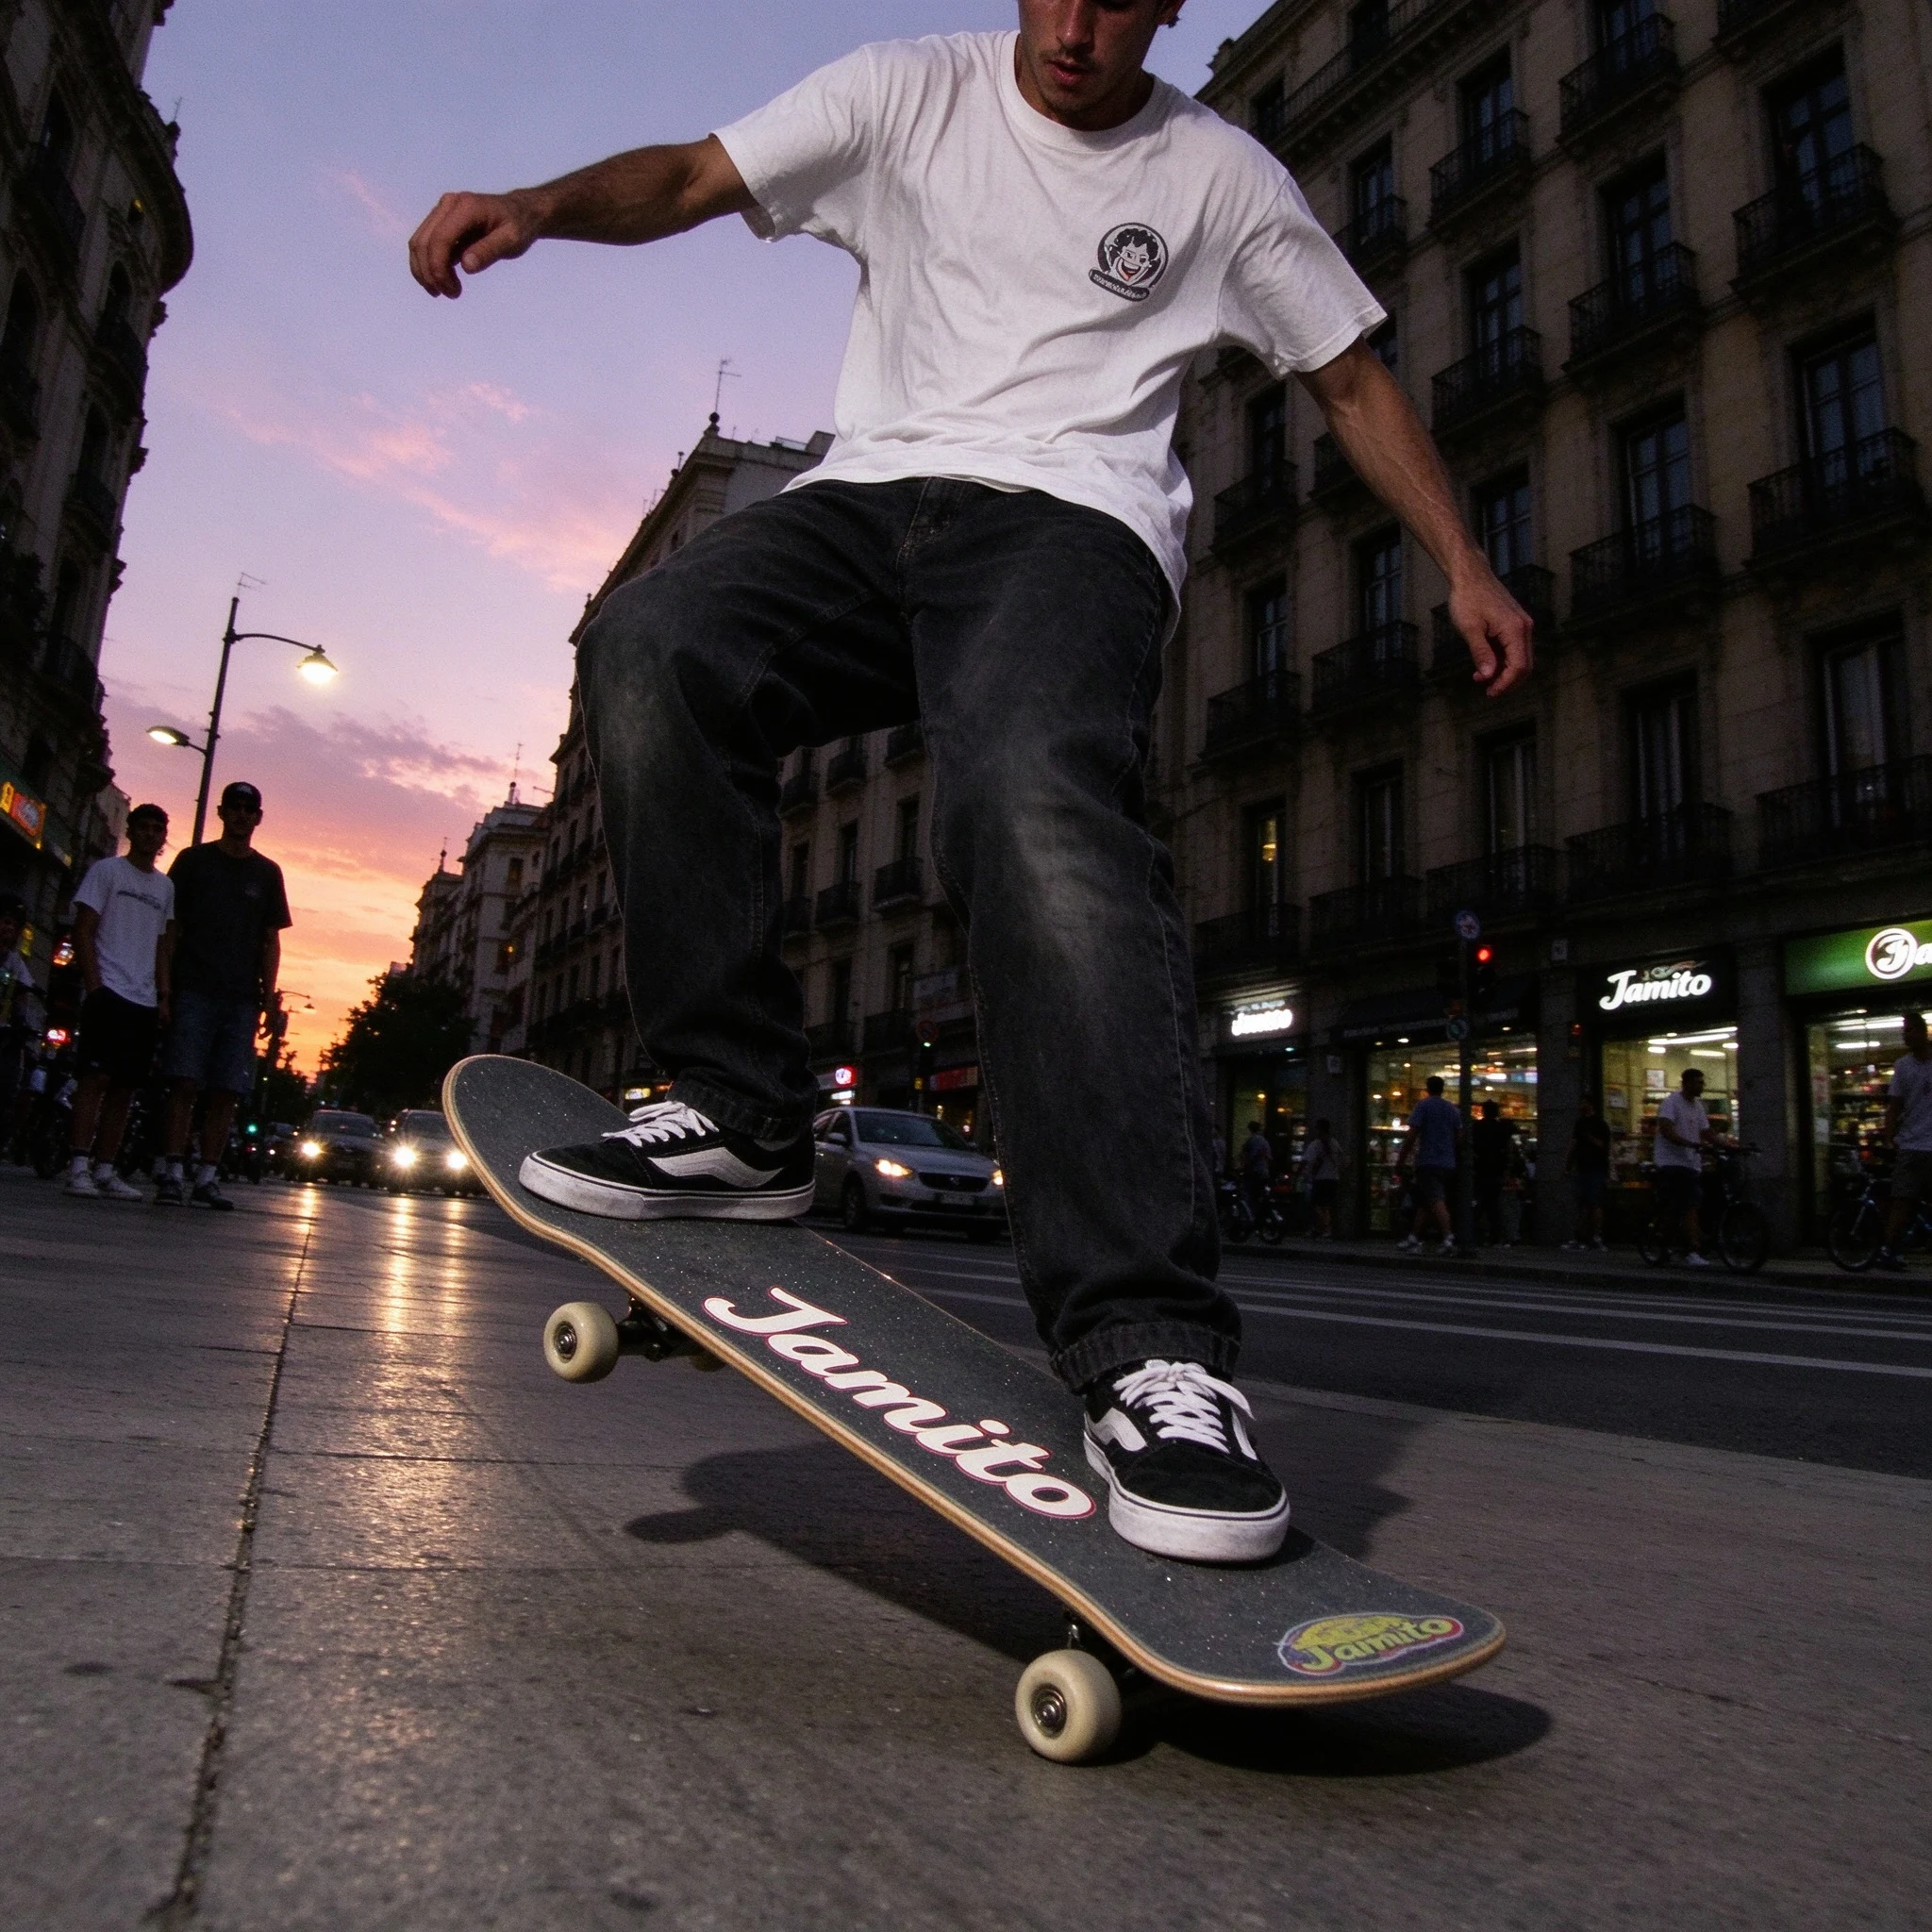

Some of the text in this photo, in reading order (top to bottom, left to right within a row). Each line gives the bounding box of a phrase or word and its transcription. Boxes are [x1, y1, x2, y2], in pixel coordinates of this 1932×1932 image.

[1599, 970, 1712, 1010] Jamito
[703, 1285, 1096, 1520] Jamito
[1294, 1618, 1454, 1671] Jamito
